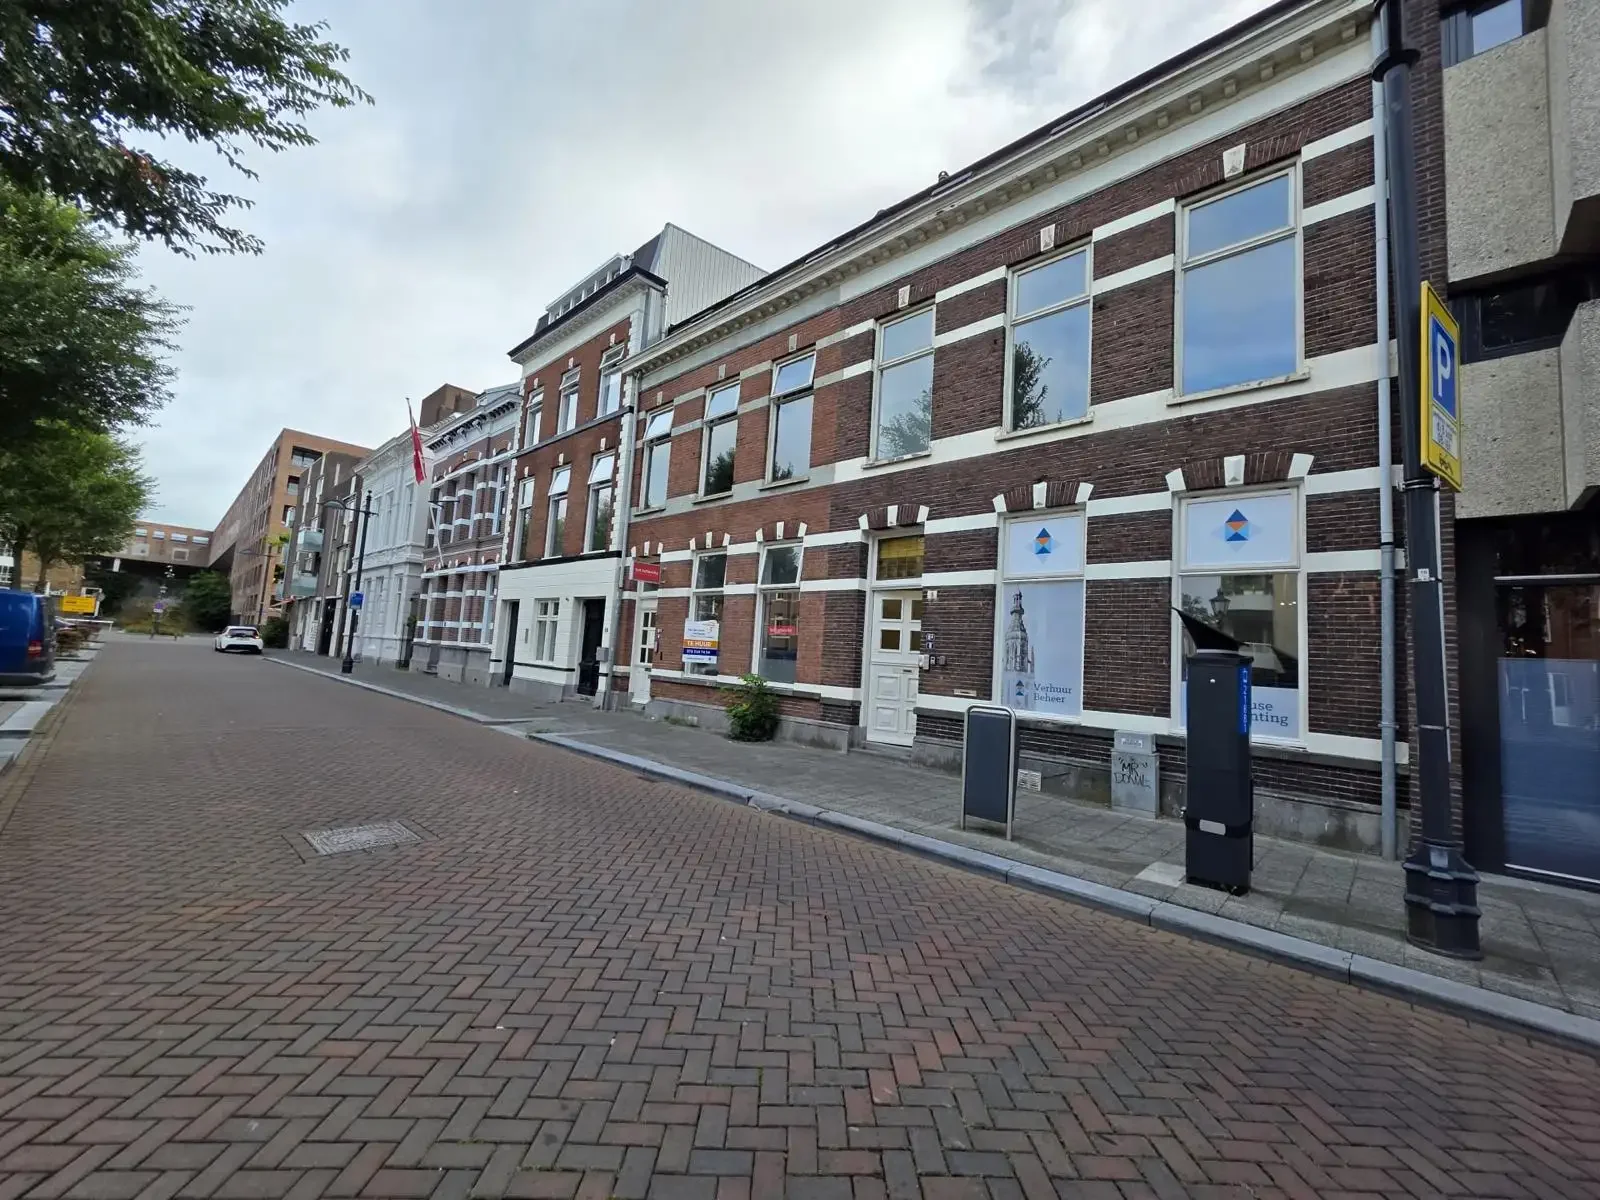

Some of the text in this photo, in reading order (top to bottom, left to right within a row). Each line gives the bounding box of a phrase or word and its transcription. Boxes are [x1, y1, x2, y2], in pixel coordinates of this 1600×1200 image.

[1437, 332, 1450, 398] P
[1034, 682, 1072, 694] Verhuur
[1033, 693, 1066, 703] Beheer
[1251, 711, 1289, 727] nting
